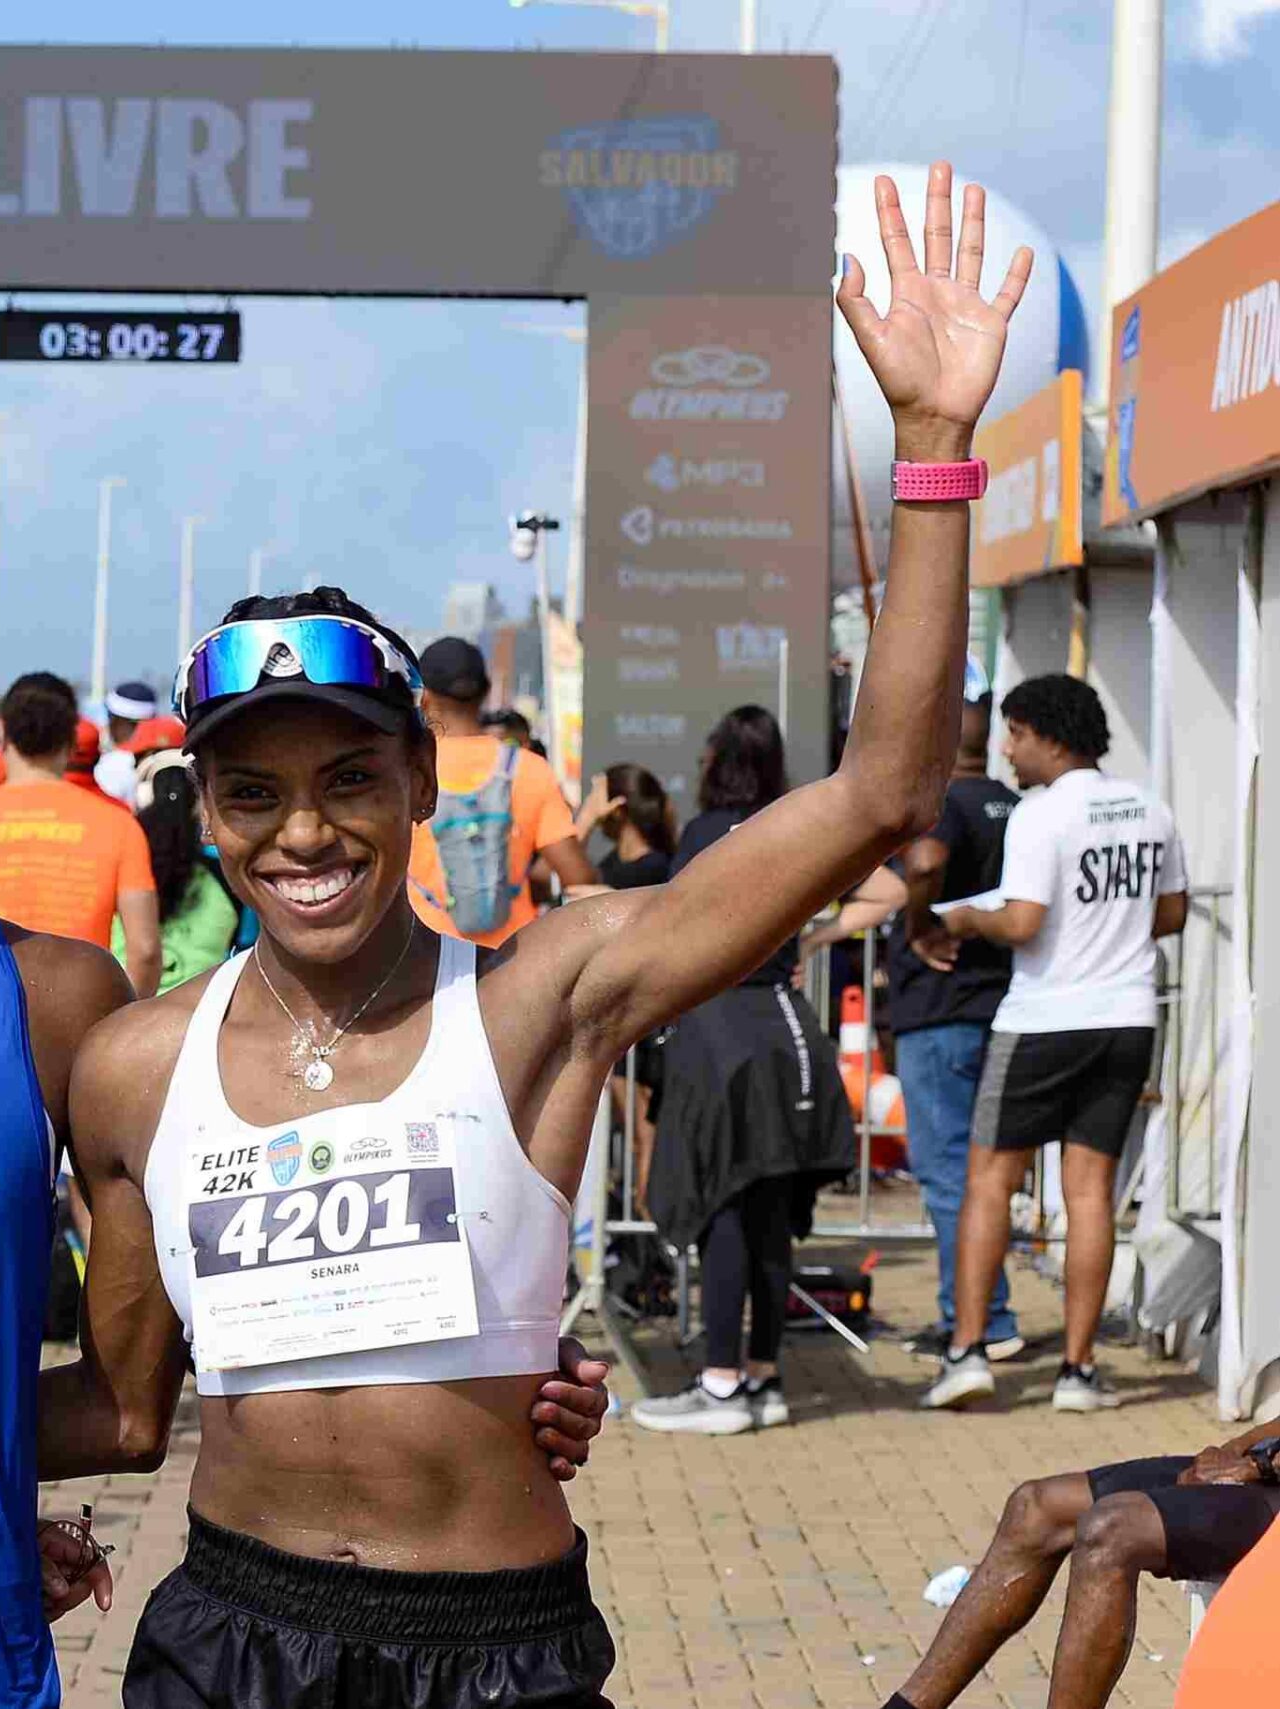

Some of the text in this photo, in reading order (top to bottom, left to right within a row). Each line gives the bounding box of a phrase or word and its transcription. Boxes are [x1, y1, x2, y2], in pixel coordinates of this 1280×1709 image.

[538, 149, 739, 188] SALVADOR
[1076, 841, 1164, 903] STAFF
[200, 1145, 261, 1172] ELITE
[202, 1170, 258, 1196] 42K
[218, 1173, 421, 1267] 4201
[310, 1262, 361, 1280] SENARA
